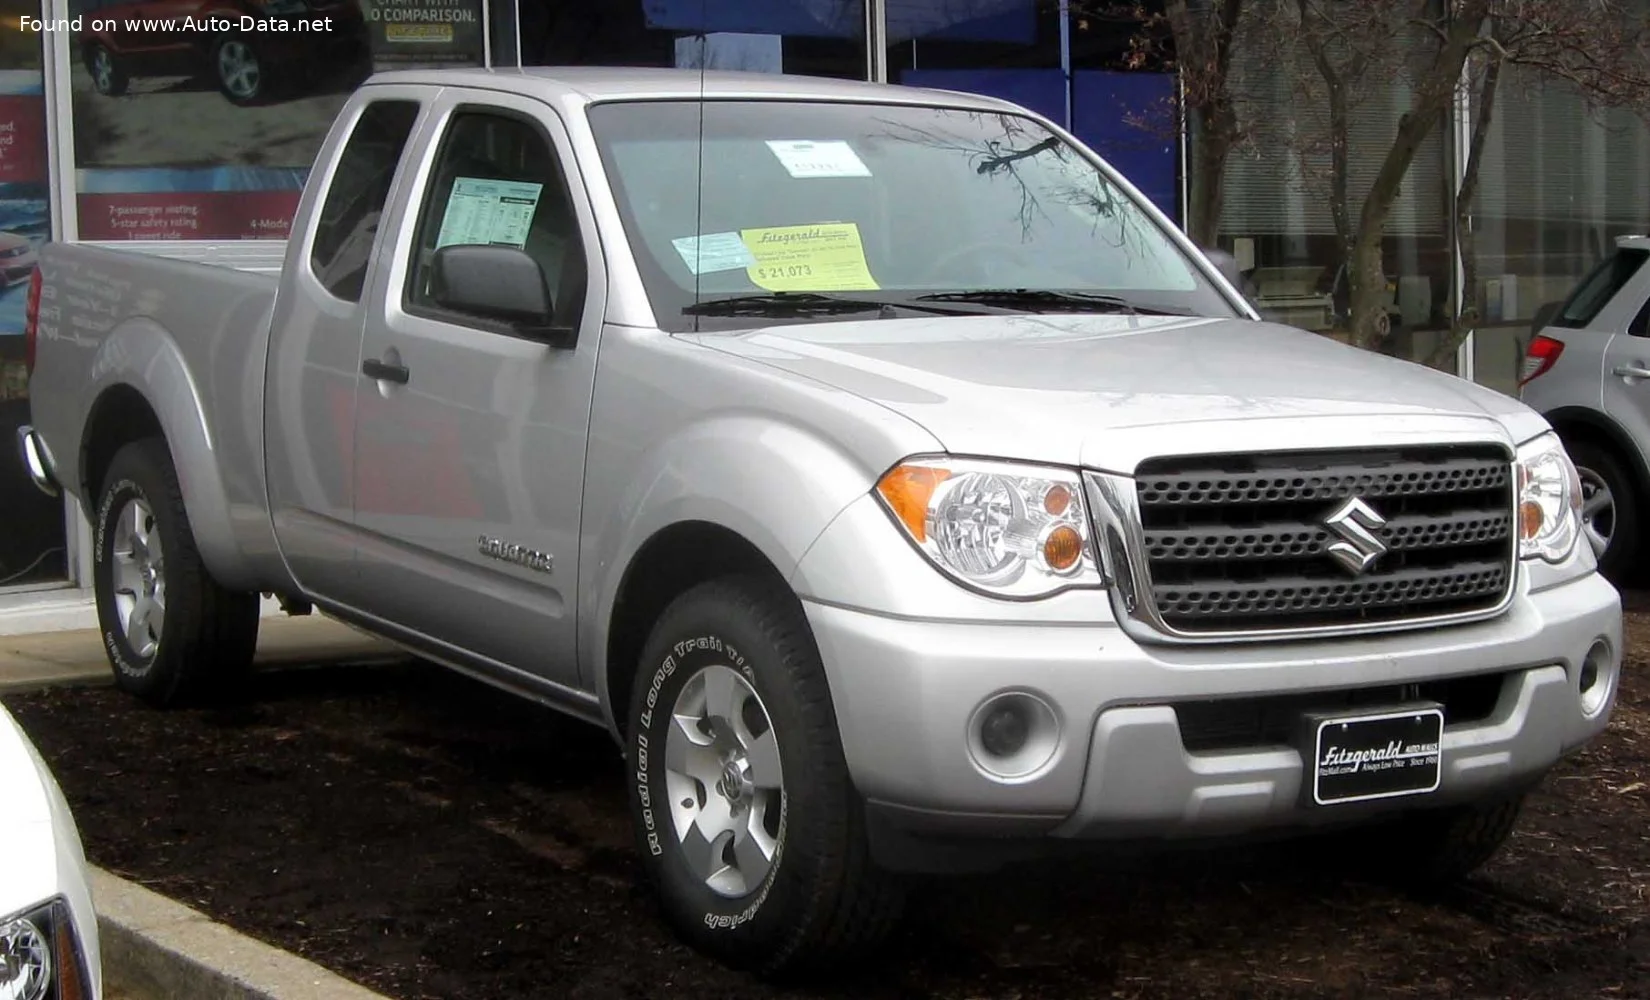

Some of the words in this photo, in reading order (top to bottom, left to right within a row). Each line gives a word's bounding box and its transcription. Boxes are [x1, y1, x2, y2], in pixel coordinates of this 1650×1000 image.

[384, 8, 476, 22] COMPARISON.
[250, 218, 289, 229] 4-Mode
[757, 229, 821, 245] Fitzgerald
[758, 269, 767, 279] $
[673, 636, 723, 658] Trail
[641, 656, 677, 730] Long
[1320, 740, 1403, 773] Fitzgerald
[1361, 763, 1380, 773] Always
[1381, 761, 1392, 769] Low
[637, 734, 663, 856] Radial
